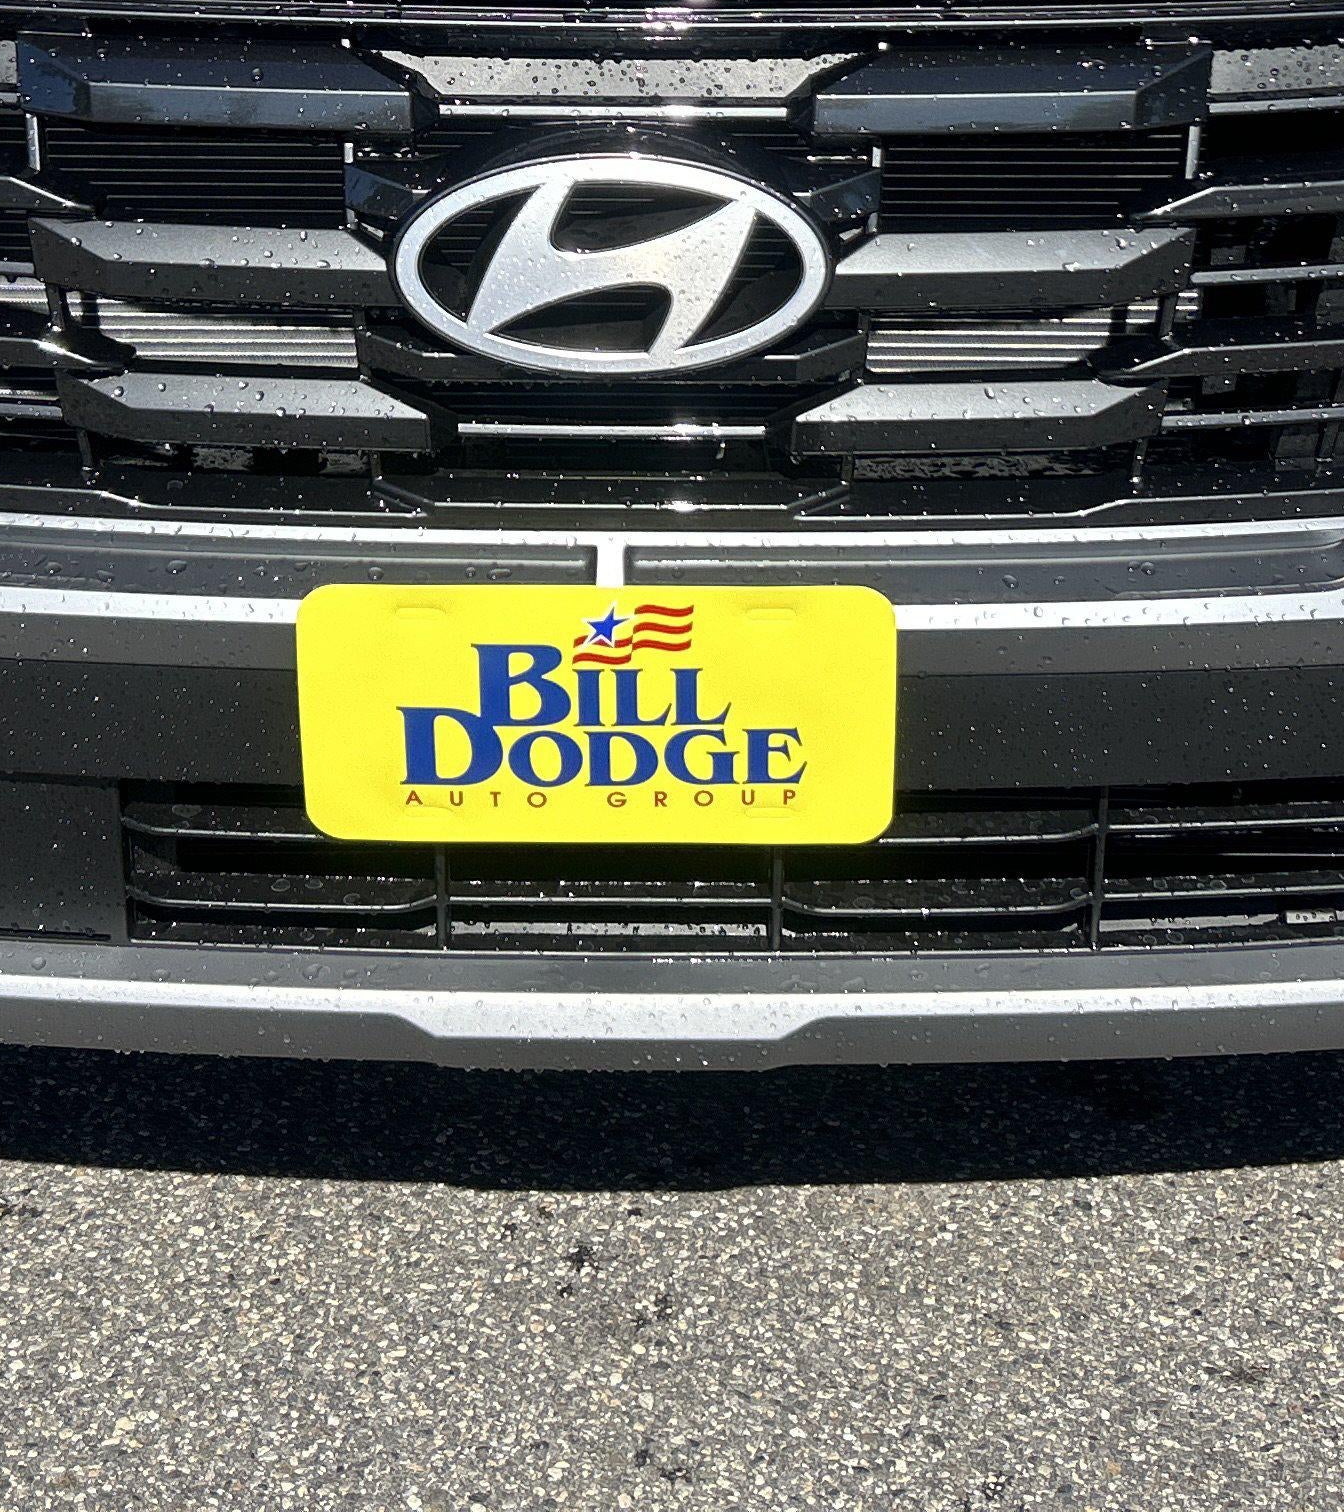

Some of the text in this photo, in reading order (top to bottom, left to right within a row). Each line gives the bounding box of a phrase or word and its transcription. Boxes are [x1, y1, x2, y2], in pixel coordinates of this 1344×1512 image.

[471, 643, 732, 727] BILL
[395, 706, 808, 788] DODGE
[405, 789, 796, 808] AUTO GROUP
